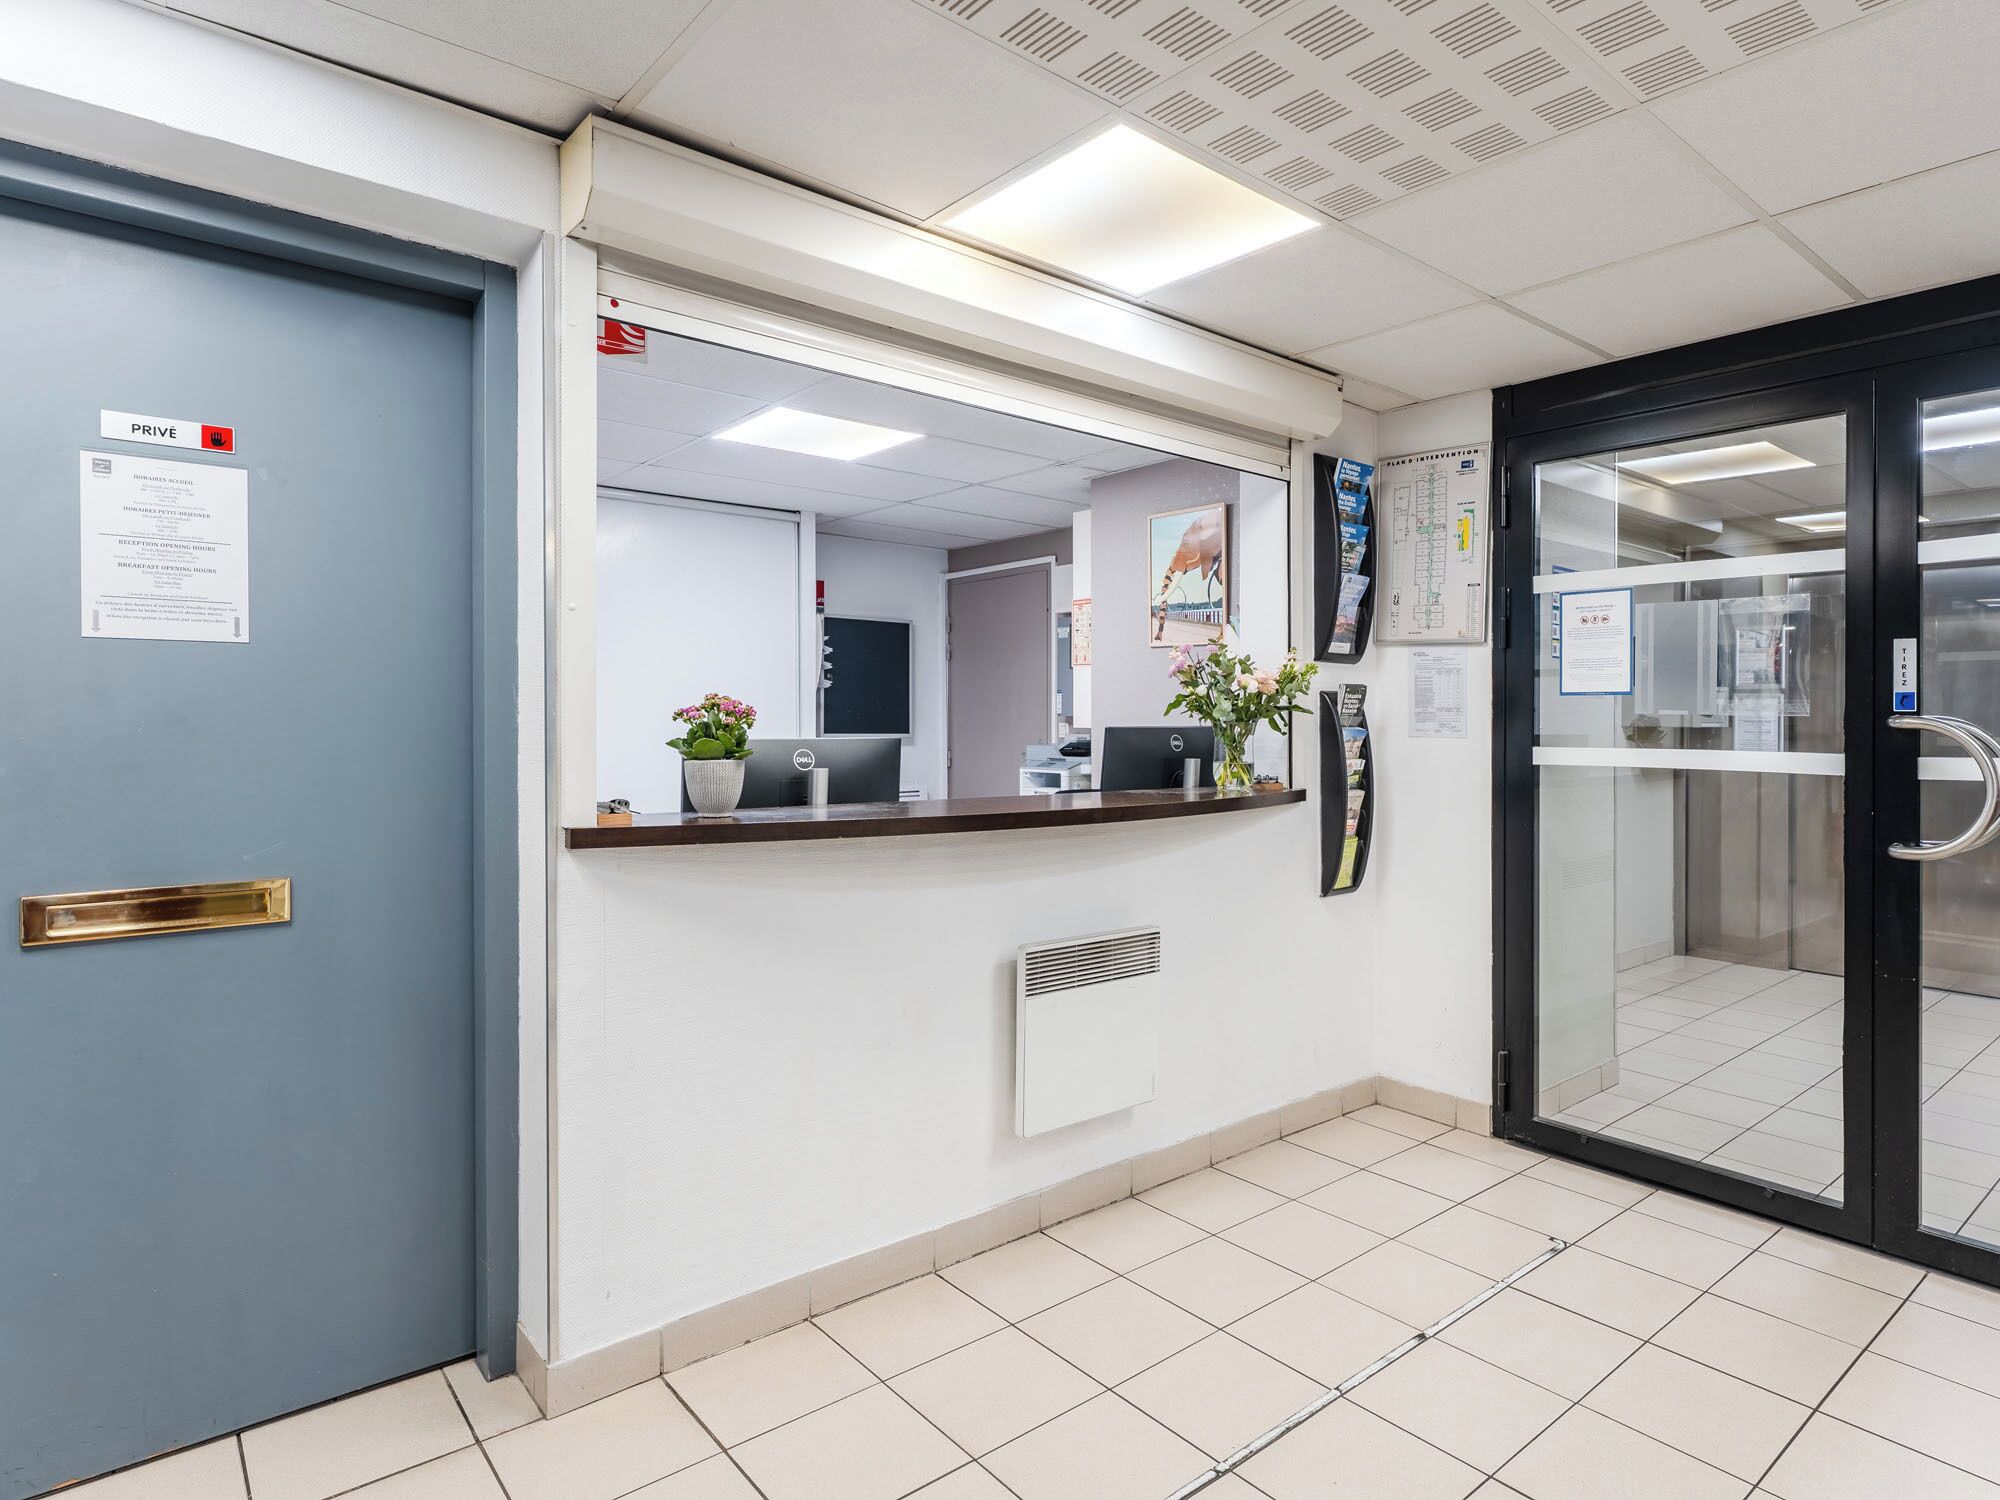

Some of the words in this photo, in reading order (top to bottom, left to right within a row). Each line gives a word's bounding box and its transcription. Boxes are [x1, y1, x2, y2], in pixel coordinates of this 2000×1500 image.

[132, 424, 176, 438] PRIVÉ
[1408, 449, 1478, 464] D'INTERVENTION
[134, 474, 166, 482] HORAIRES
[168, 478, 194, 486] ACCUEIL
[124, 506, 156, 514] HORAIRES
[118, 539, 158, 548] RECEPTION
[160, 542, 190, 551] OPENING
[118, 562, 160, 571] BREAKFAST
[161, 565, 192, 573] OPENING
